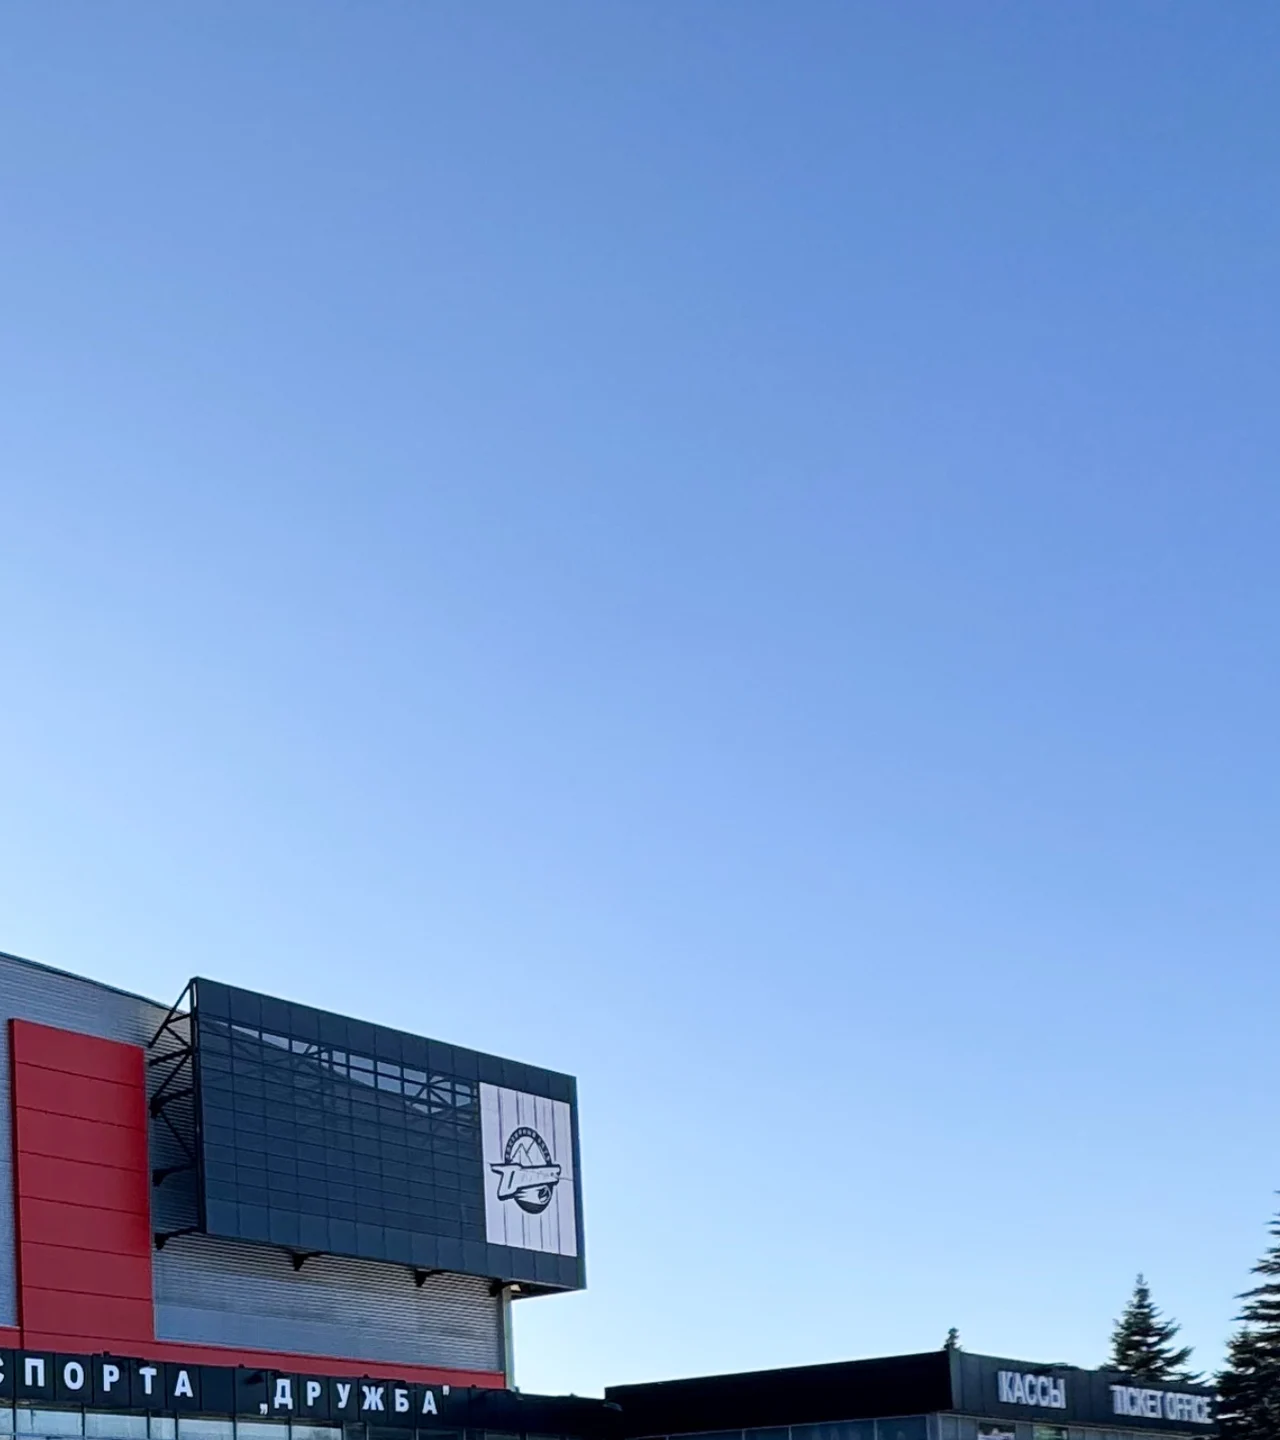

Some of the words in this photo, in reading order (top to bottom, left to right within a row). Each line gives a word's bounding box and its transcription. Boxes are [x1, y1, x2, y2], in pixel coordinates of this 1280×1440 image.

[997, 1370, 1067, 1409] КАССЫ
[1109, 1385, 1163, 1419] TICKET
[1164, 1391, 1214, 1424] OFFICE
